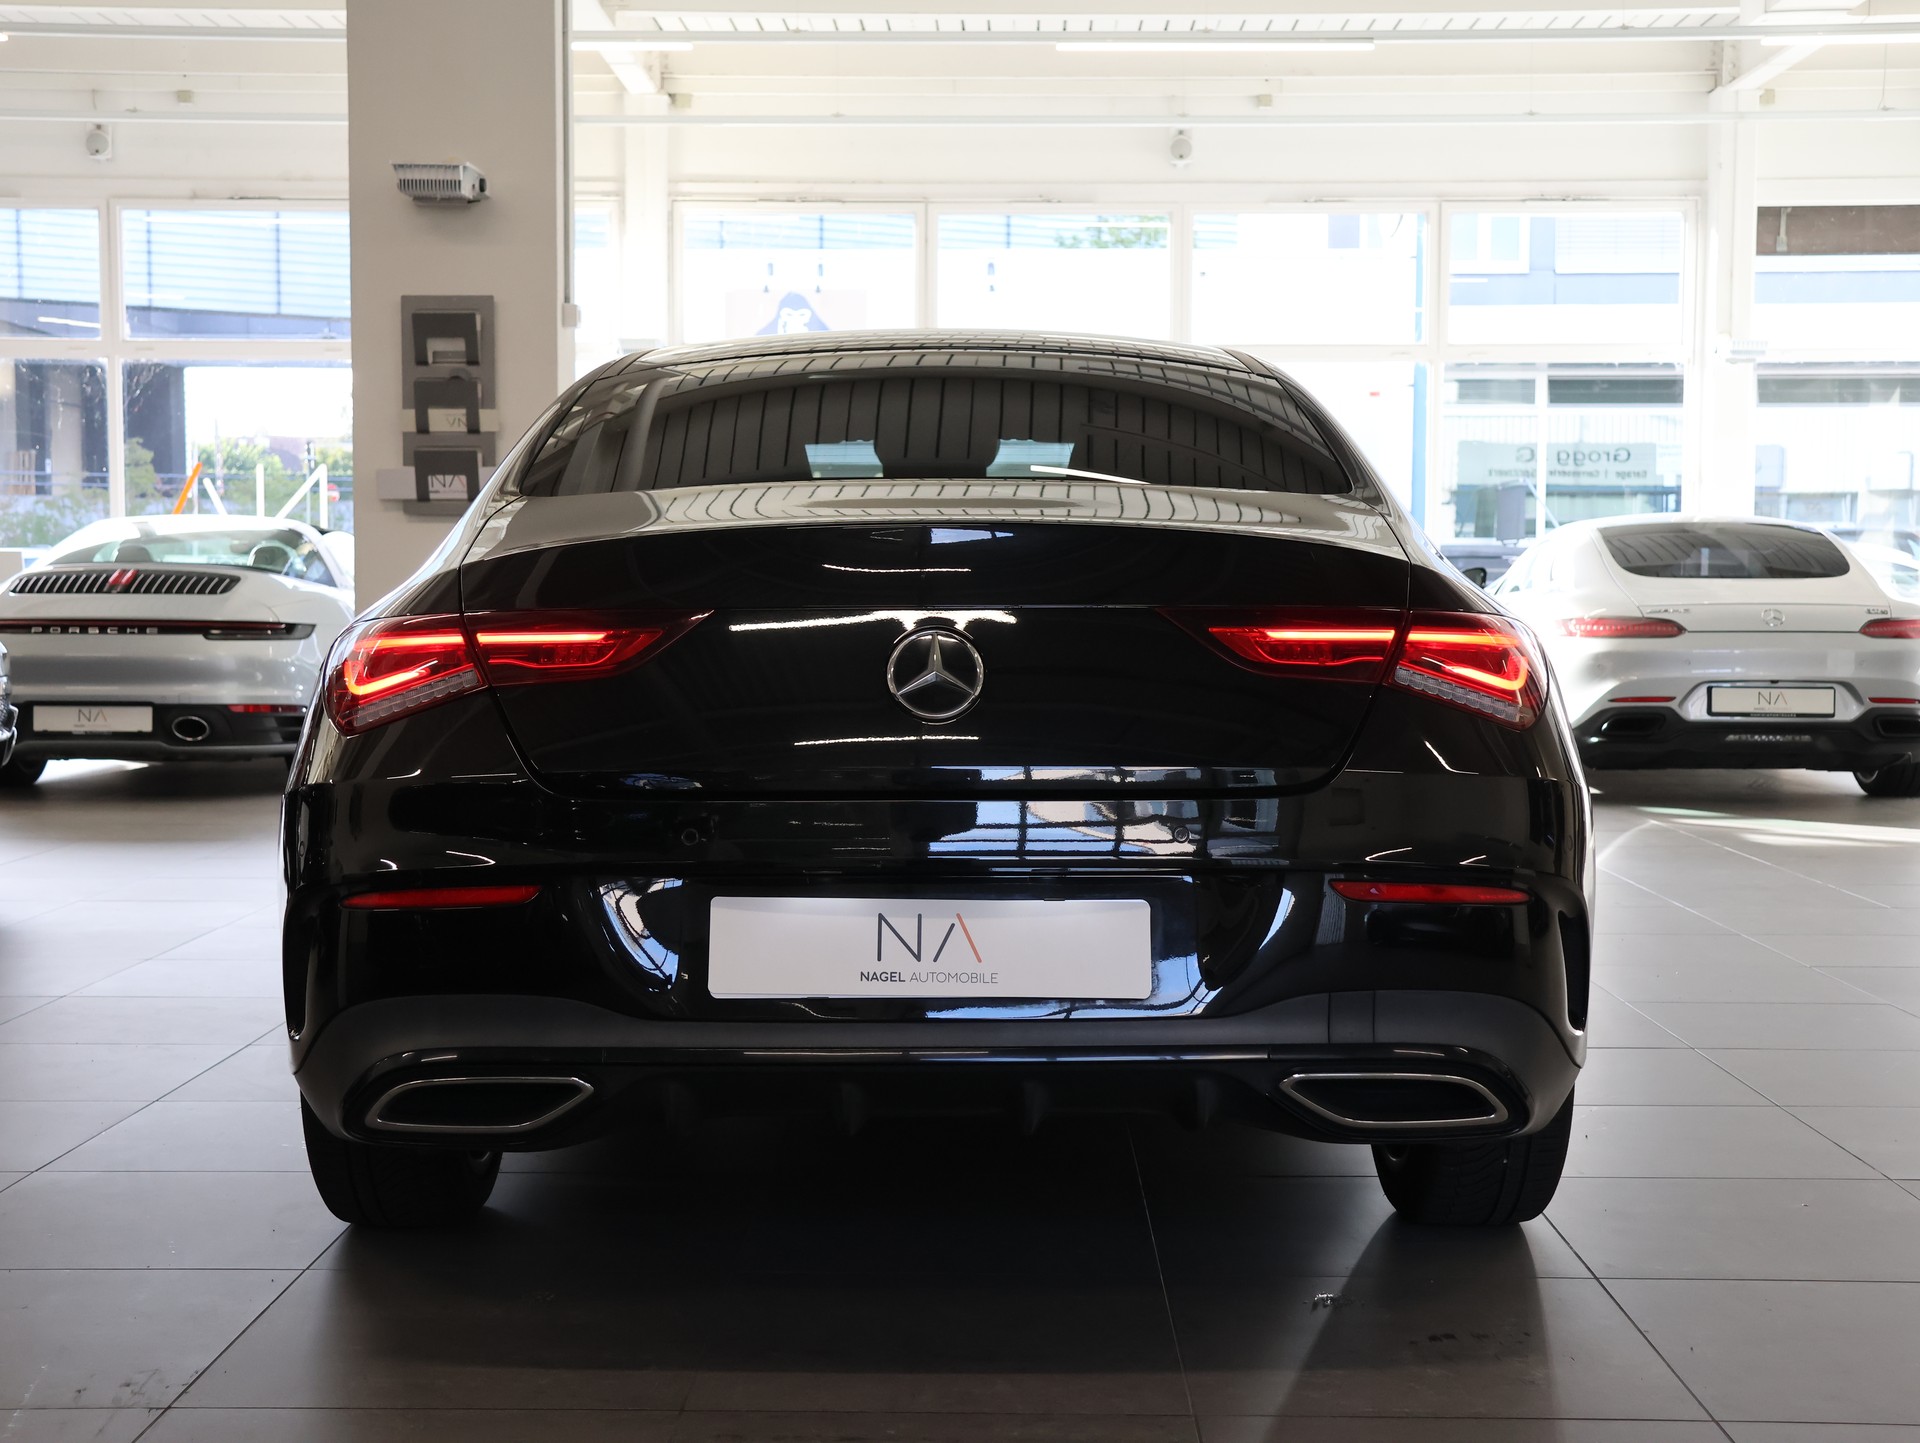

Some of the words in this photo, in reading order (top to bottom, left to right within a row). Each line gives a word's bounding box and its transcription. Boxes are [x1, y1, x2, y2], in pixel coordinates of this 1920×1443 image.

[31, 626, 158, 634] PORSCHE
[1757, 691, 1788, 705] NA
[78, 708, 108, 722] NA
[877, 912, 982, 963] NA
[860, 971, 906, 983] NAGEL
[909, 971, 999, 984] AUTOMOBILE
